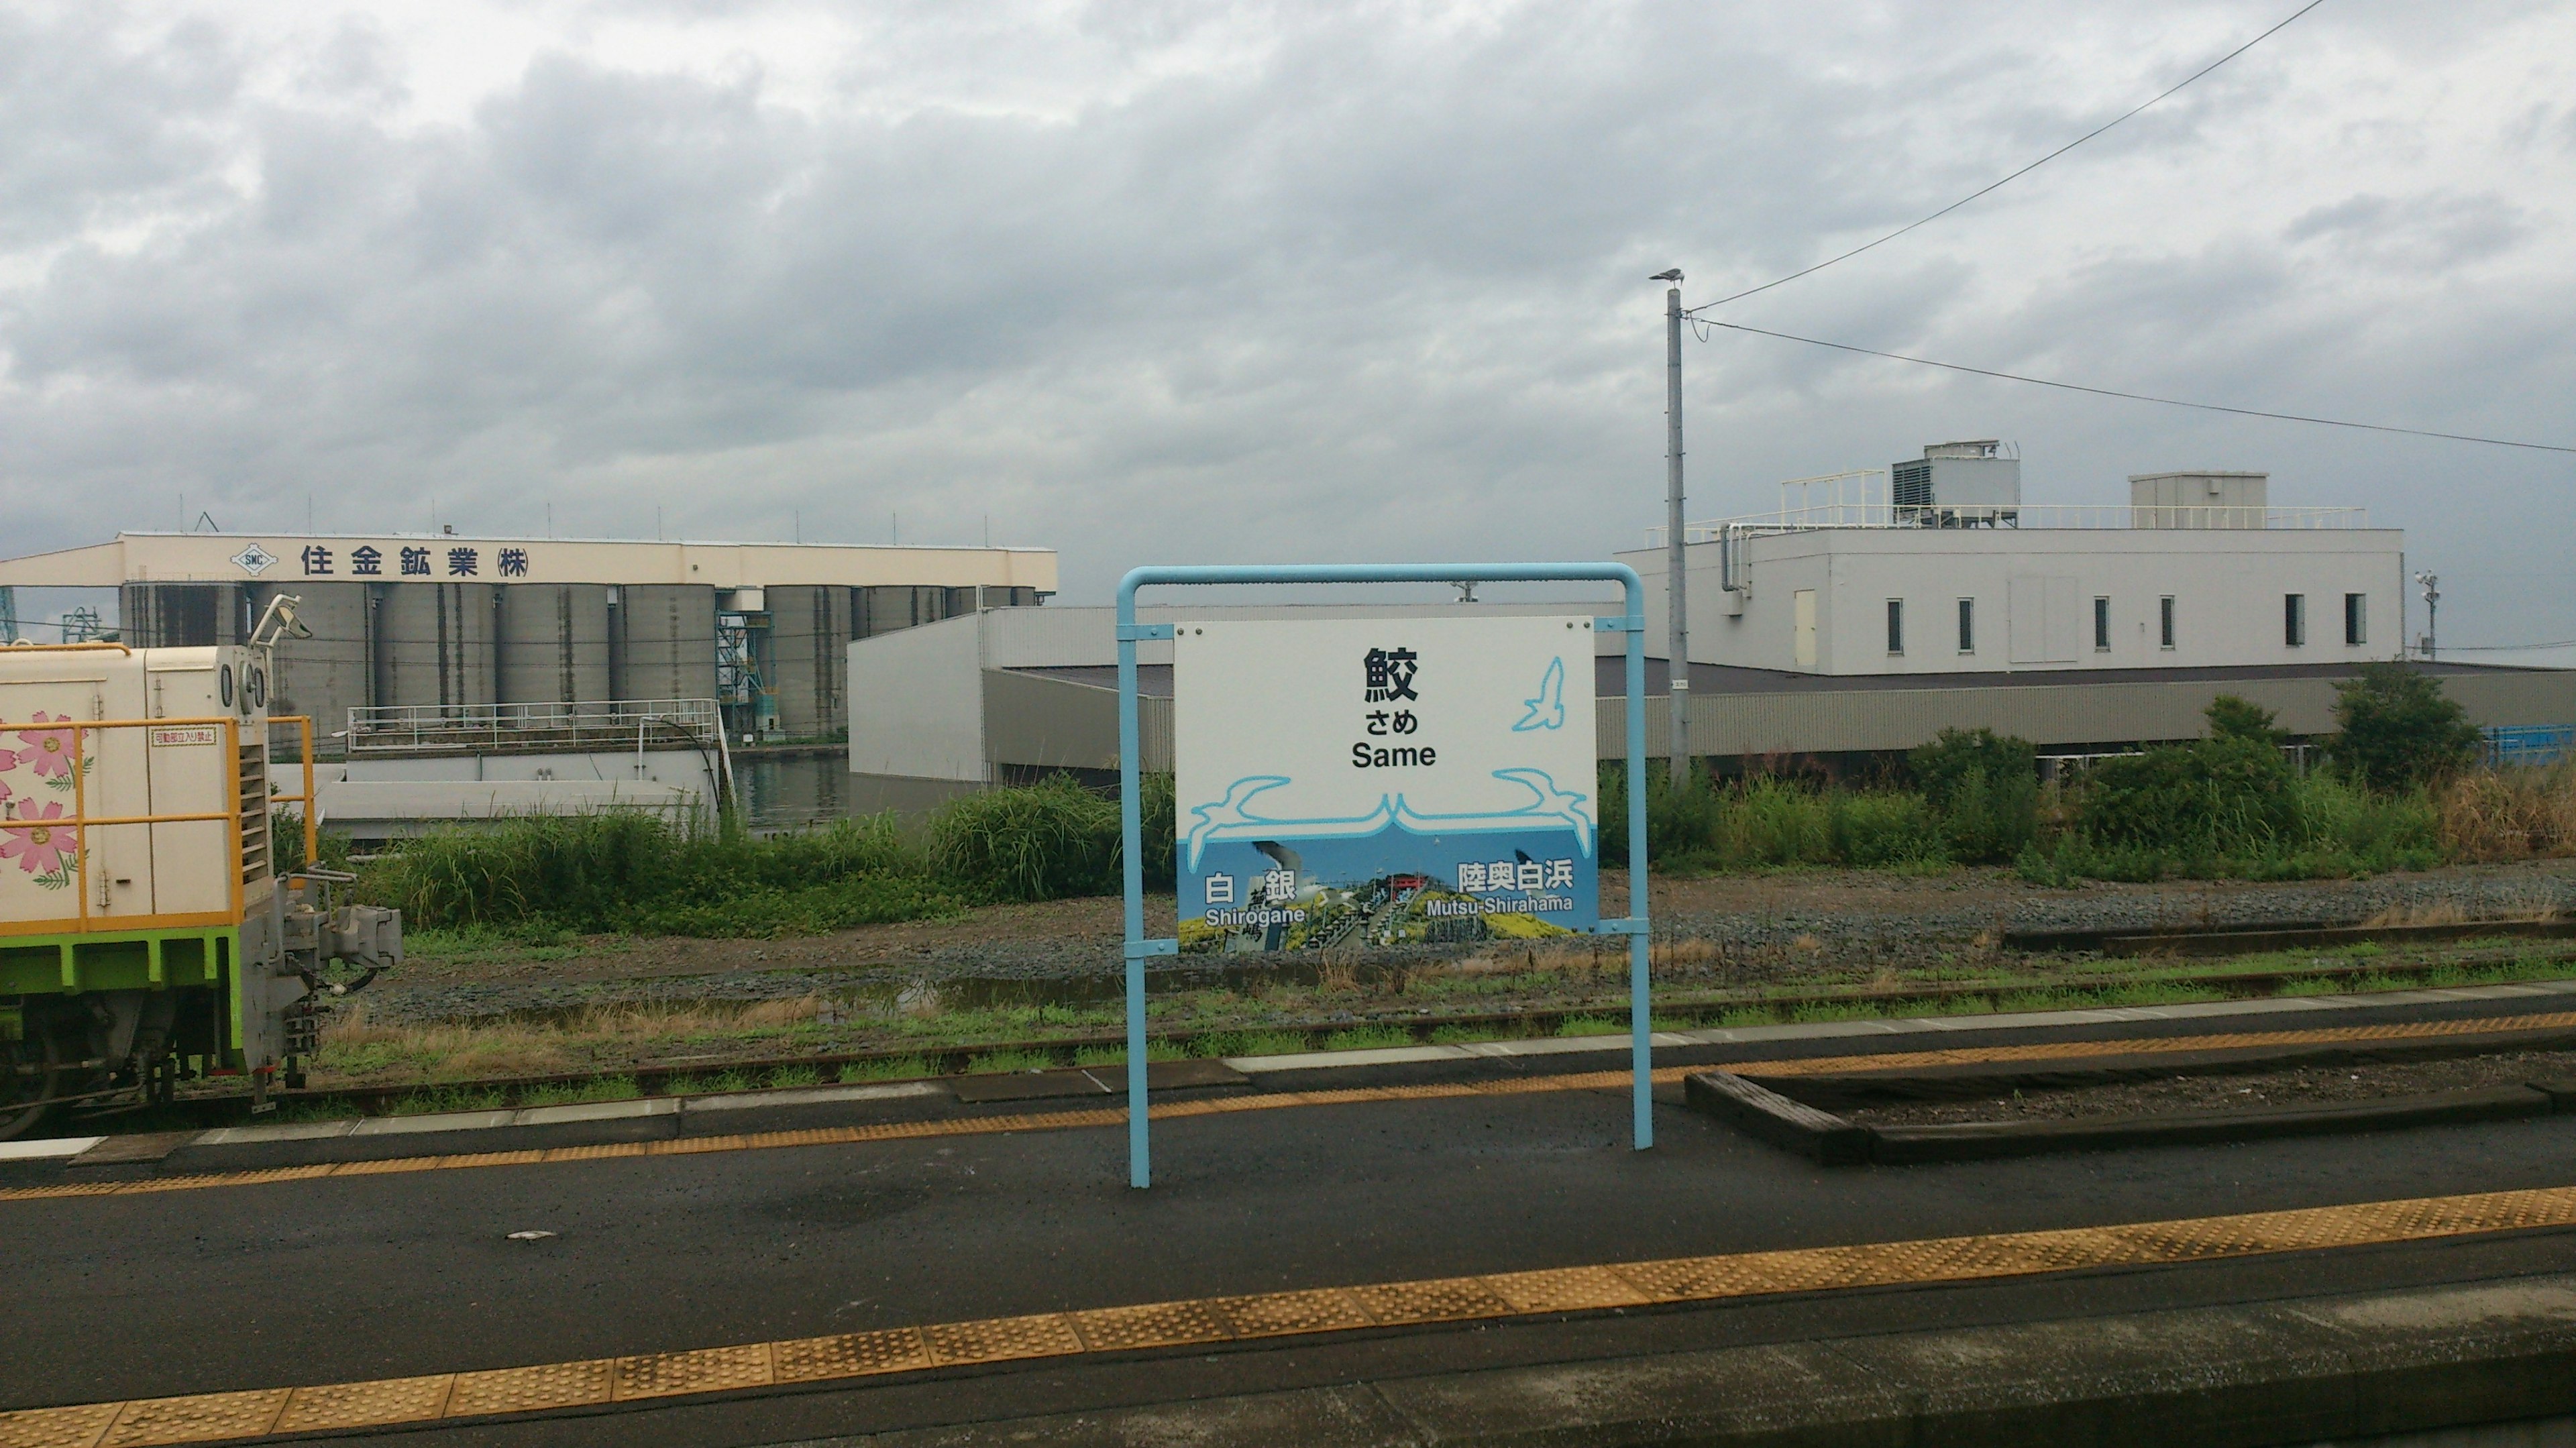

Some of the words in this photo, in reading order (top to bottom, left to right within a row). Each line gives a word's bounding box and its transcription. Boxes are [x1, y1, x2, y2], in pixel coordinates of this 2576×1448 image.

[246, 555, 262, 565] SMC
[1364, 647, 1418, 703] 鮫
[1366, 710, 1417, 735] さめ
[1352, 742, 1436, 768] Same
[1458, 858, 1574, 893] 陸奥白浜
[1205, 907, 1305, 928] Shirogane
[1427, 895, 1573, 916] Mutsu-Shirahama
